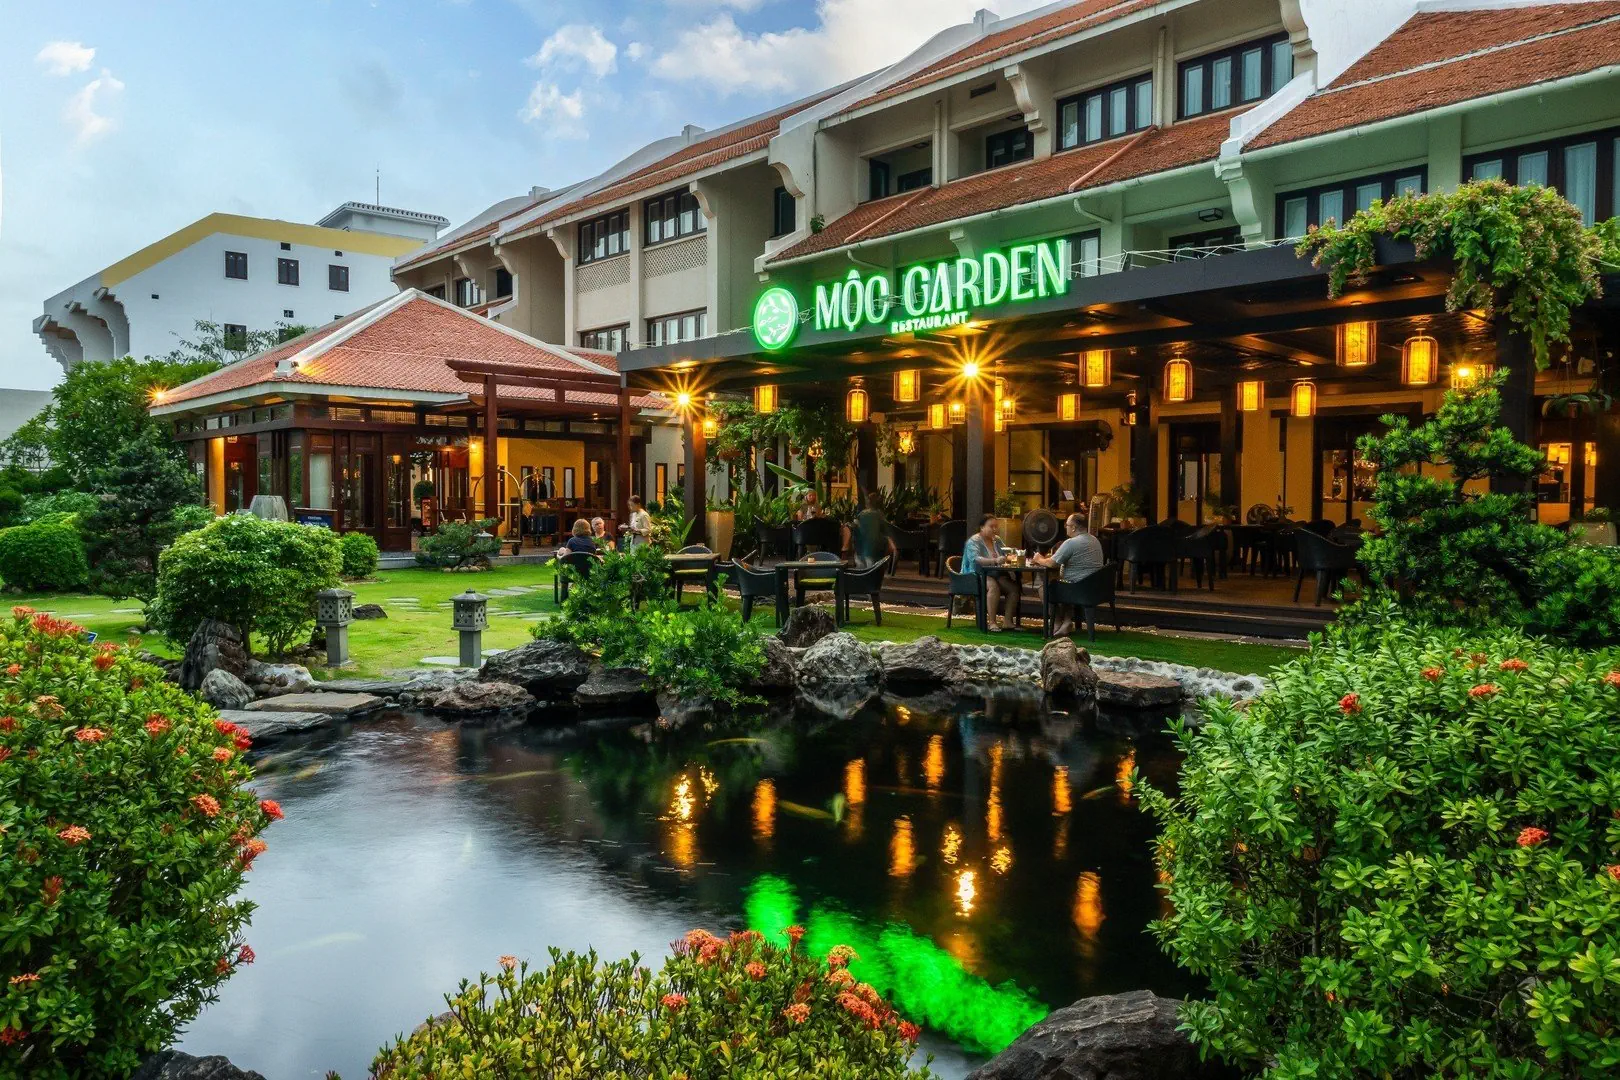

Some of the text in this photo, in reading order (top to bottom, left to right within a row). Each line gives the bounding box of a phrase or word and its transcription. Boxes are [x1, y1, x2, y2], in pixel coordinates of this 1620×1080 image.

[815, 239, 1067, 331] MỘC GARDEN
[891, 311, 969, 334] RESTAURANT
